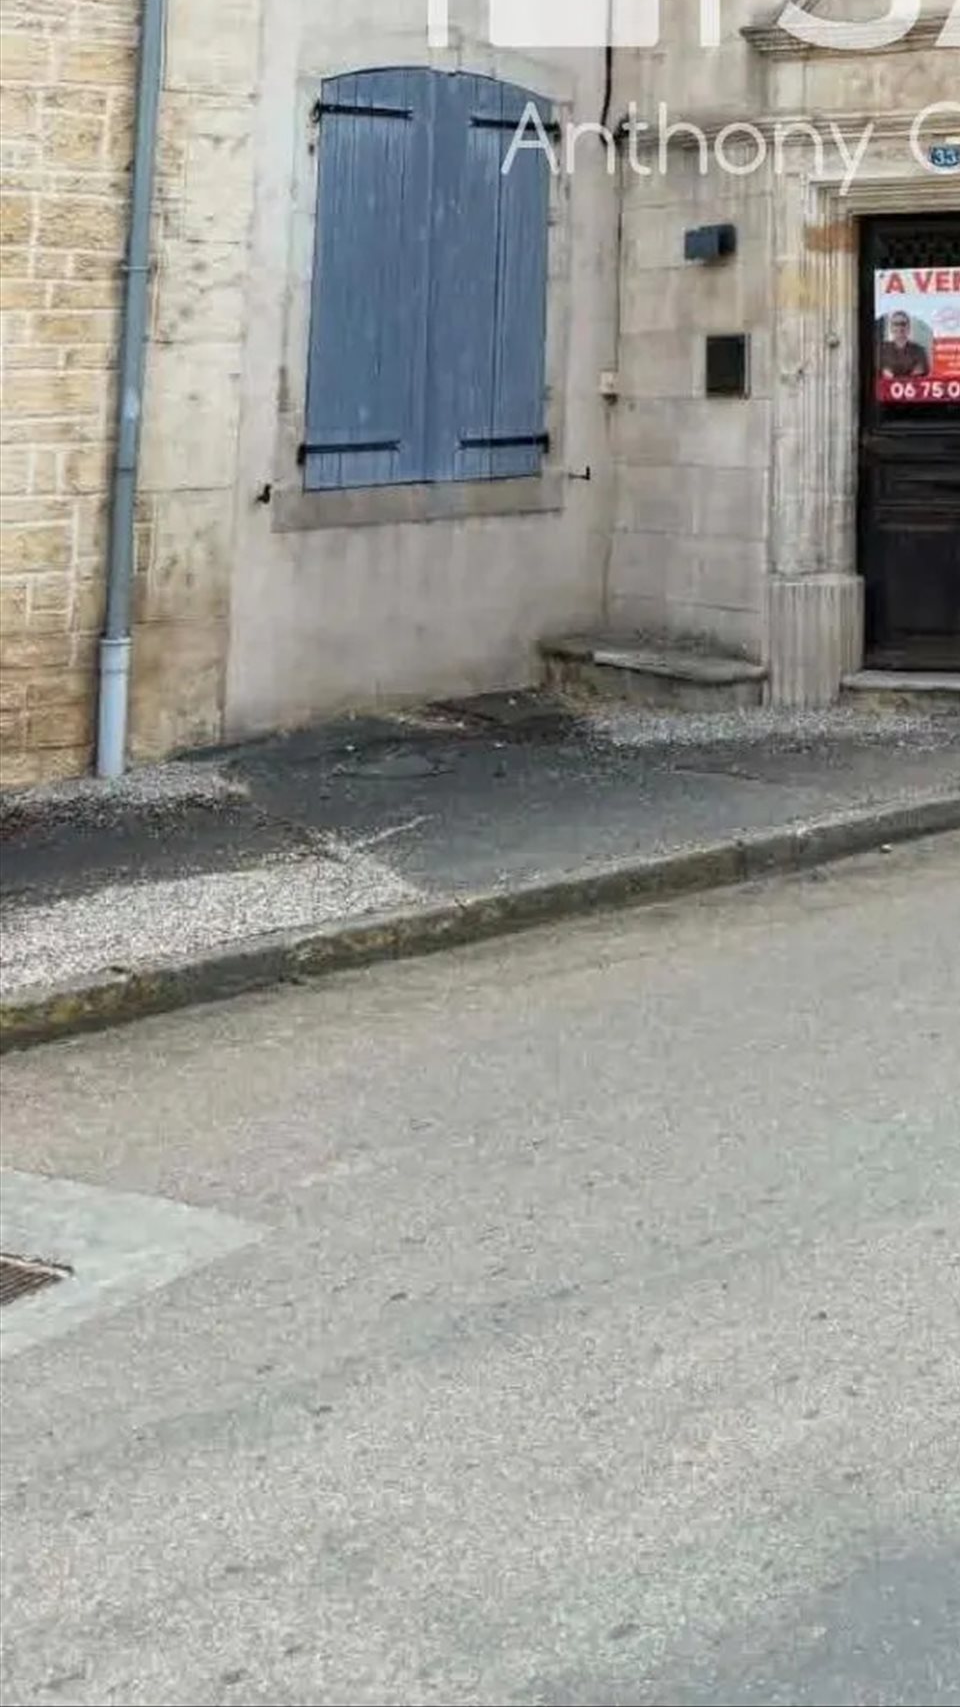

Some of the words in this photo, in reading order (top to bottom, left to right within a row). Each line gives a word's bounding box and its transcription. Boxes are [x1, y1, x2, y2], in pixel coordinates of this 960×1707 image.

[886, 273, 905, 293] A
[890, 382, 916, 399] 06
[920, 381, 944, 398] 75
